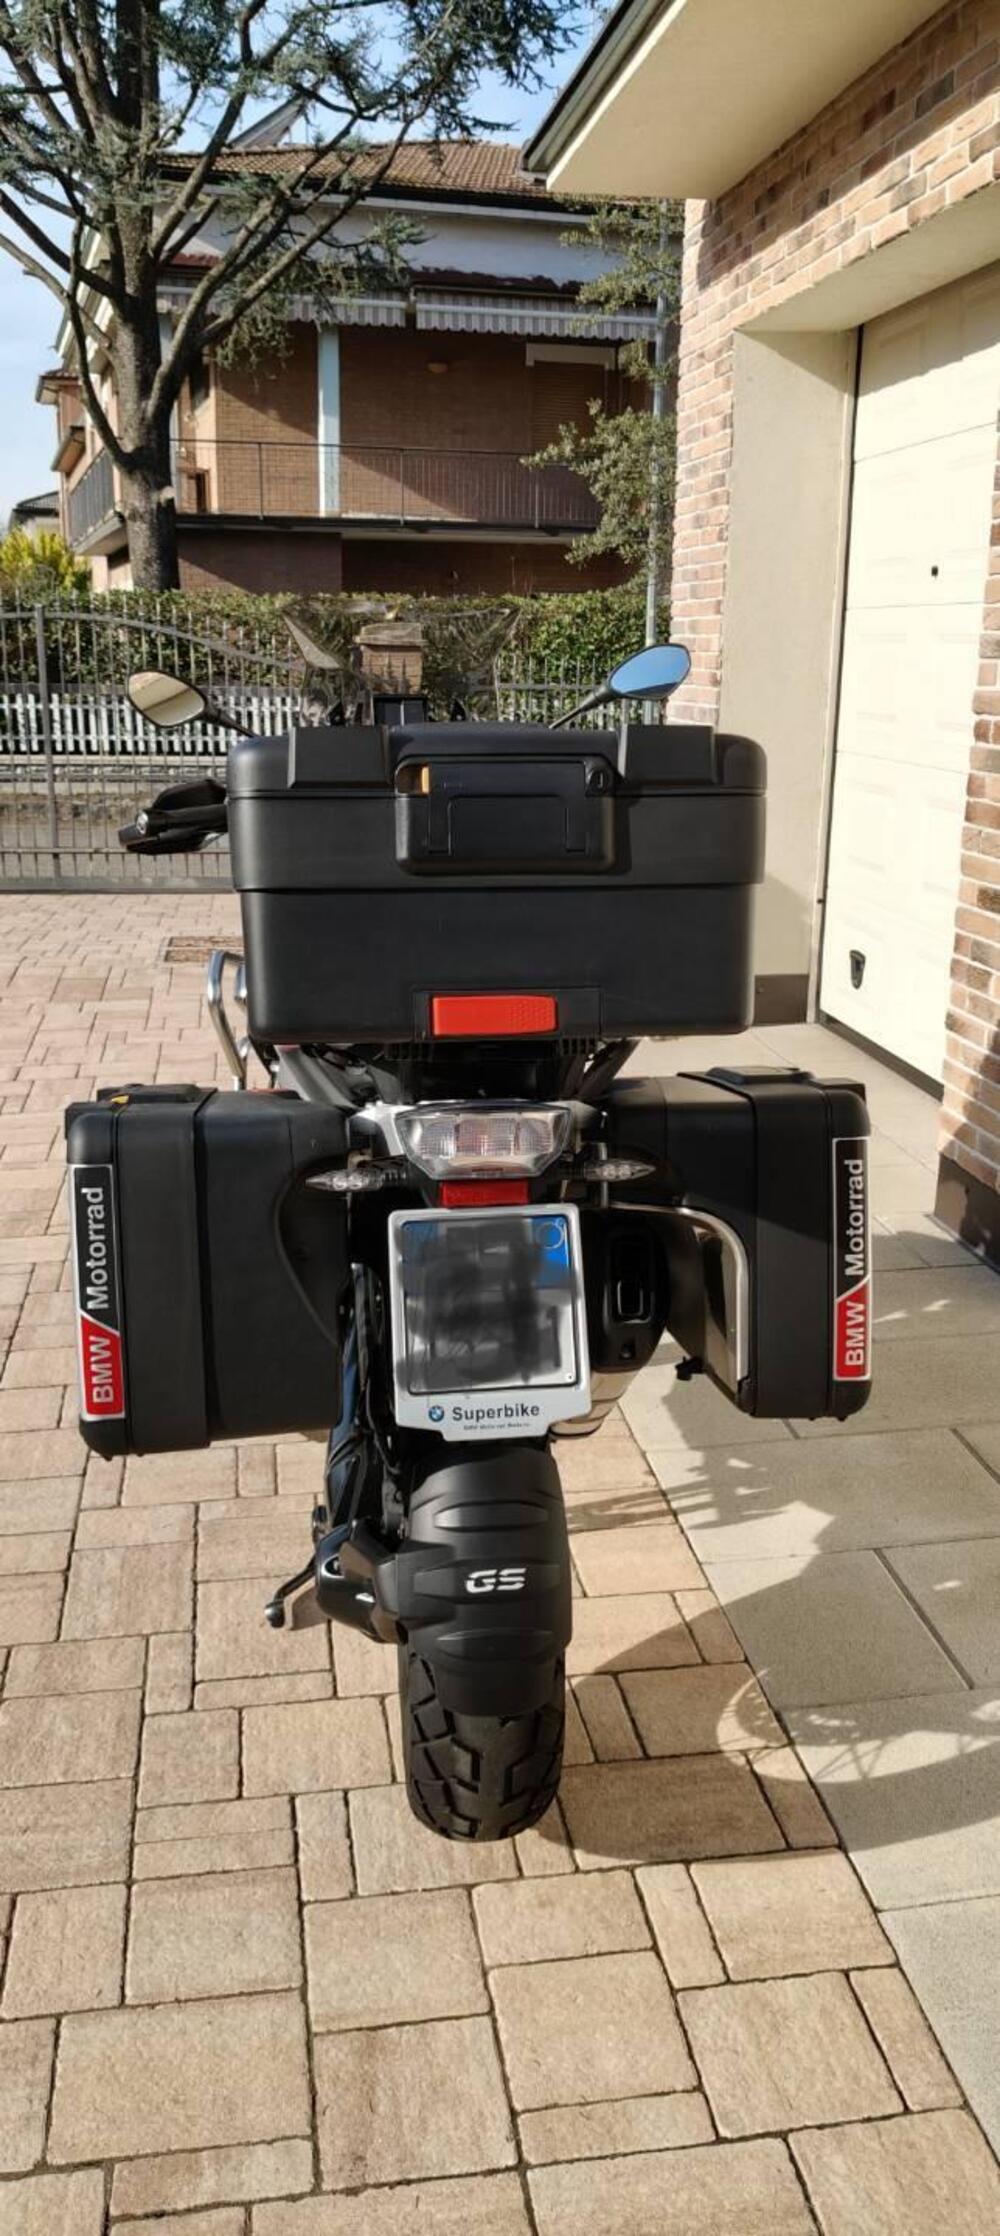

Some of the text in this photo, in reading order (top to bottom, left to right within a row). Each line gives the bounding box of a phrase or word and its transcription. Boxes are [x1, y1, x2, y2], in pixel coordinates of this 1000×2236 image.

[81, 1187, 114, 1403] BMW Motorrad
[844, 1159, 865, 1366] BMW Motorrad
[452, 1403, 540, 1422] Superbike
[465, 1568, 527, 1593] GS
